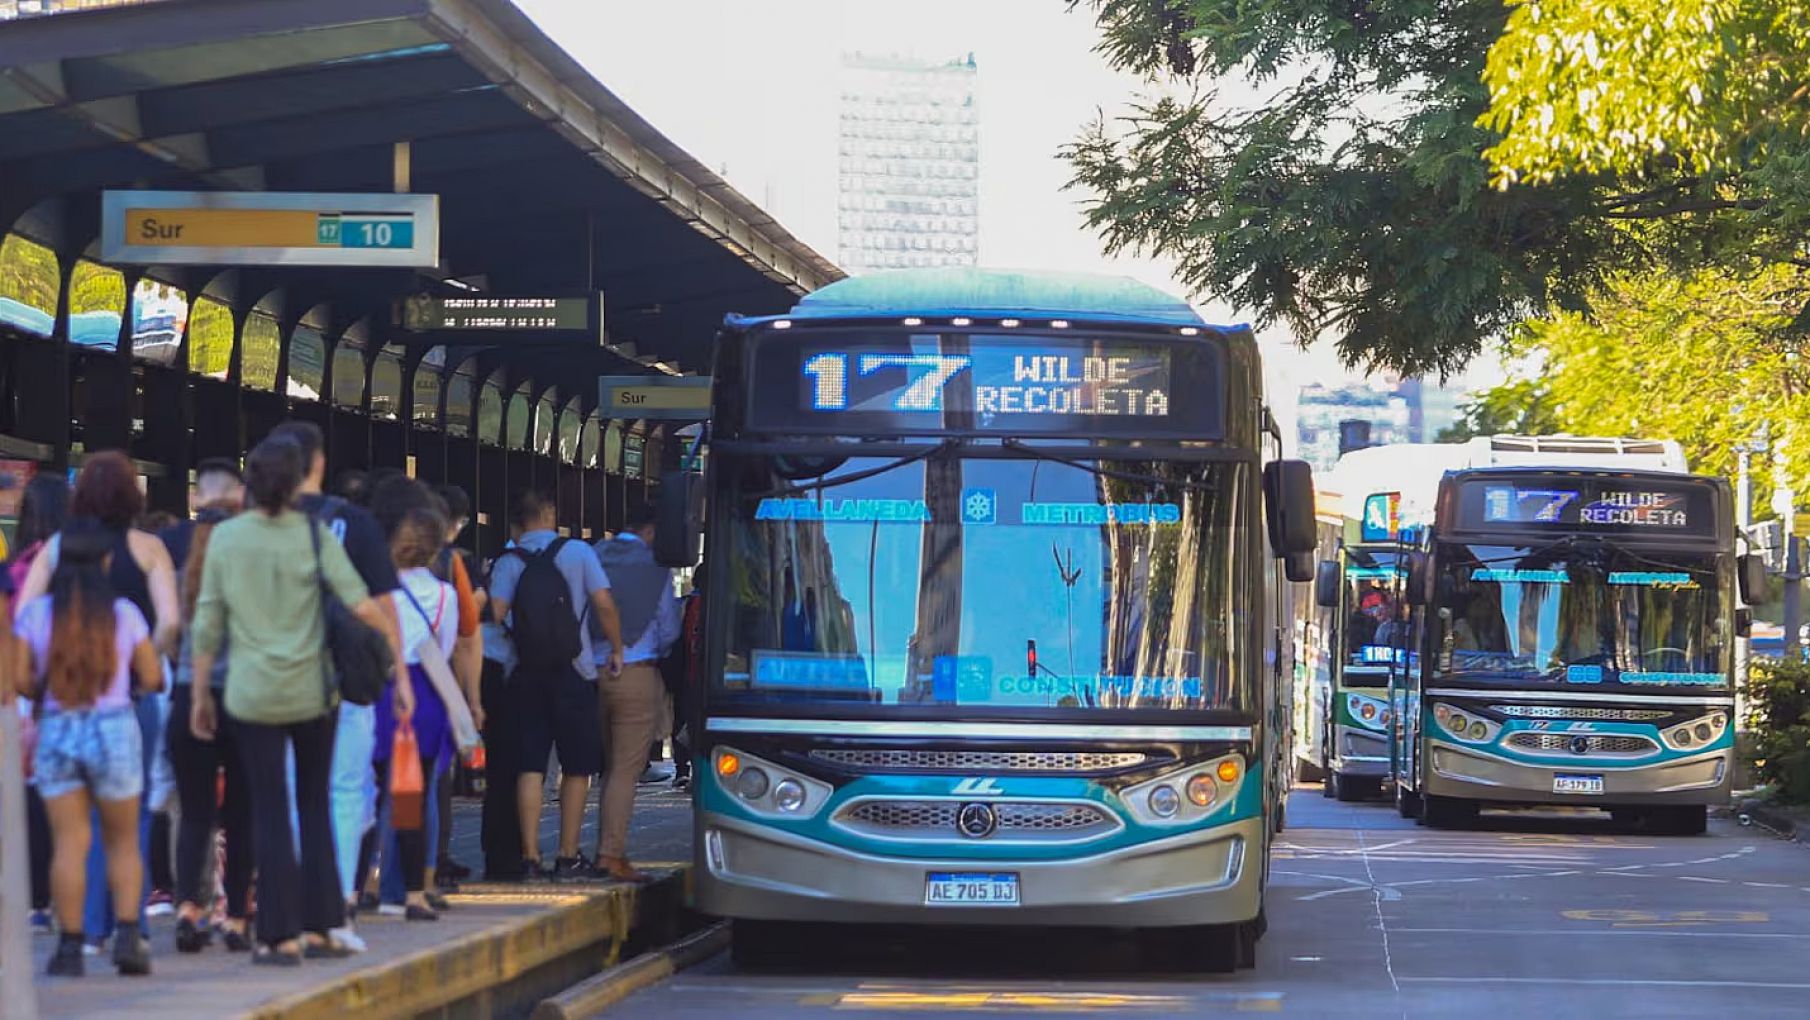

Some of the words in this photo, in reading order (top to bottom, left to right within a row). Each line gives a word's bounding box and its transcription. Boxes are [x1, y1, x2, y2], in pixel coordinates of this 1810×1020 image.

[140, 218, 184, 240] Sur
[319, 224, 339, 238] 17
[360, 223, 392, 245] 10
[1014, 355, 1131, 383] WILDE
[804, 351, 973, 411] 17
[621, 391, 647, 404] Sur
[976, 386, 1170, 416] RECOLETA
[755, 499, 931, 522] AVELLANEDA
[1485, 487, 1579, 522] 17
[1601, 491, 1665, 507] WILDE
[1021, 502, 1182, 525] METROBUS
[1580, 508, 1687, 526] RECOLETA
[932, 883, 953, 899] AE
[956, 884, 988, 899] 705
